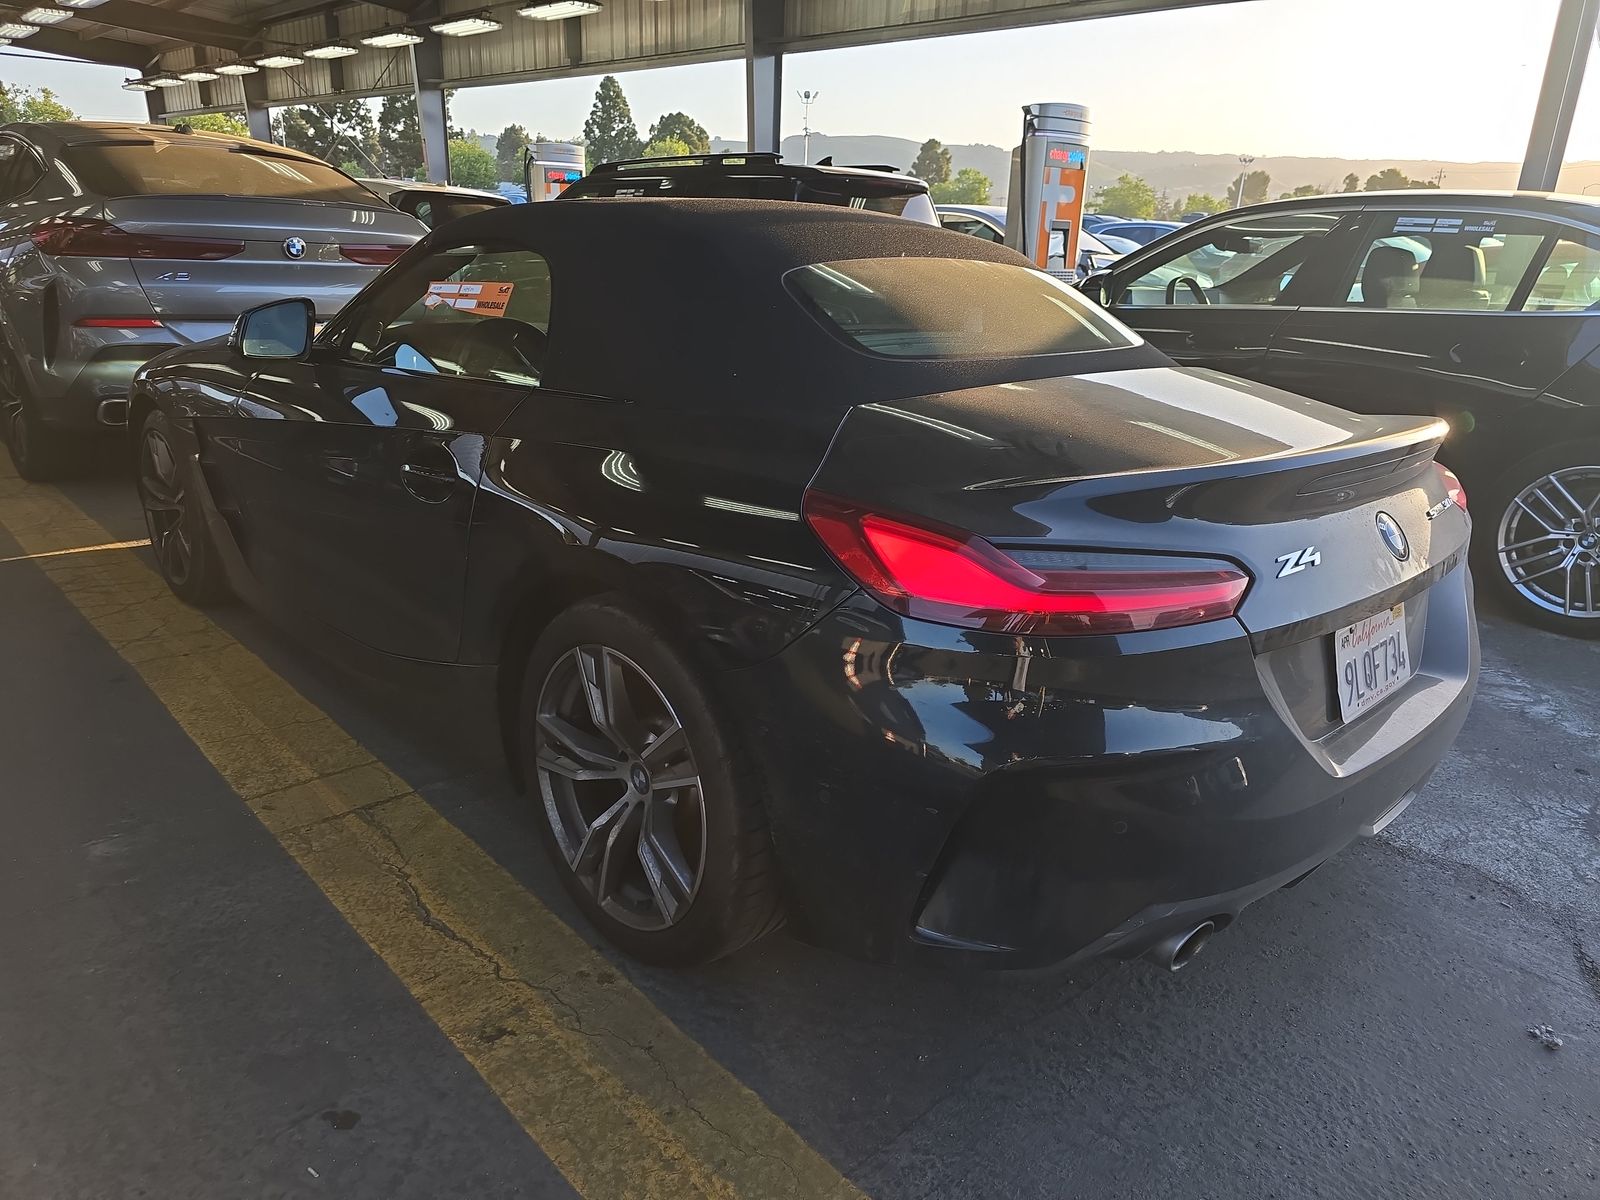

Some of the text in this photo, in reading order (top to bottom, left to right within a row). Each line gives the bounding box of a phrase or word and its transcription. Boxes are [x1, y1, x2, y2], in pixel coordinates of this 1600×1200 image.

[498, 285, 511, 294] SIXT
[476, 300, 506, 310] WHOLESALE
[1275, 546, 1322, 579] Z4
[1341, 634, 1350, 650] APR
[1351, 616, 1394, 648] California
[1344, 630, 1406, 707] 9LQF734
